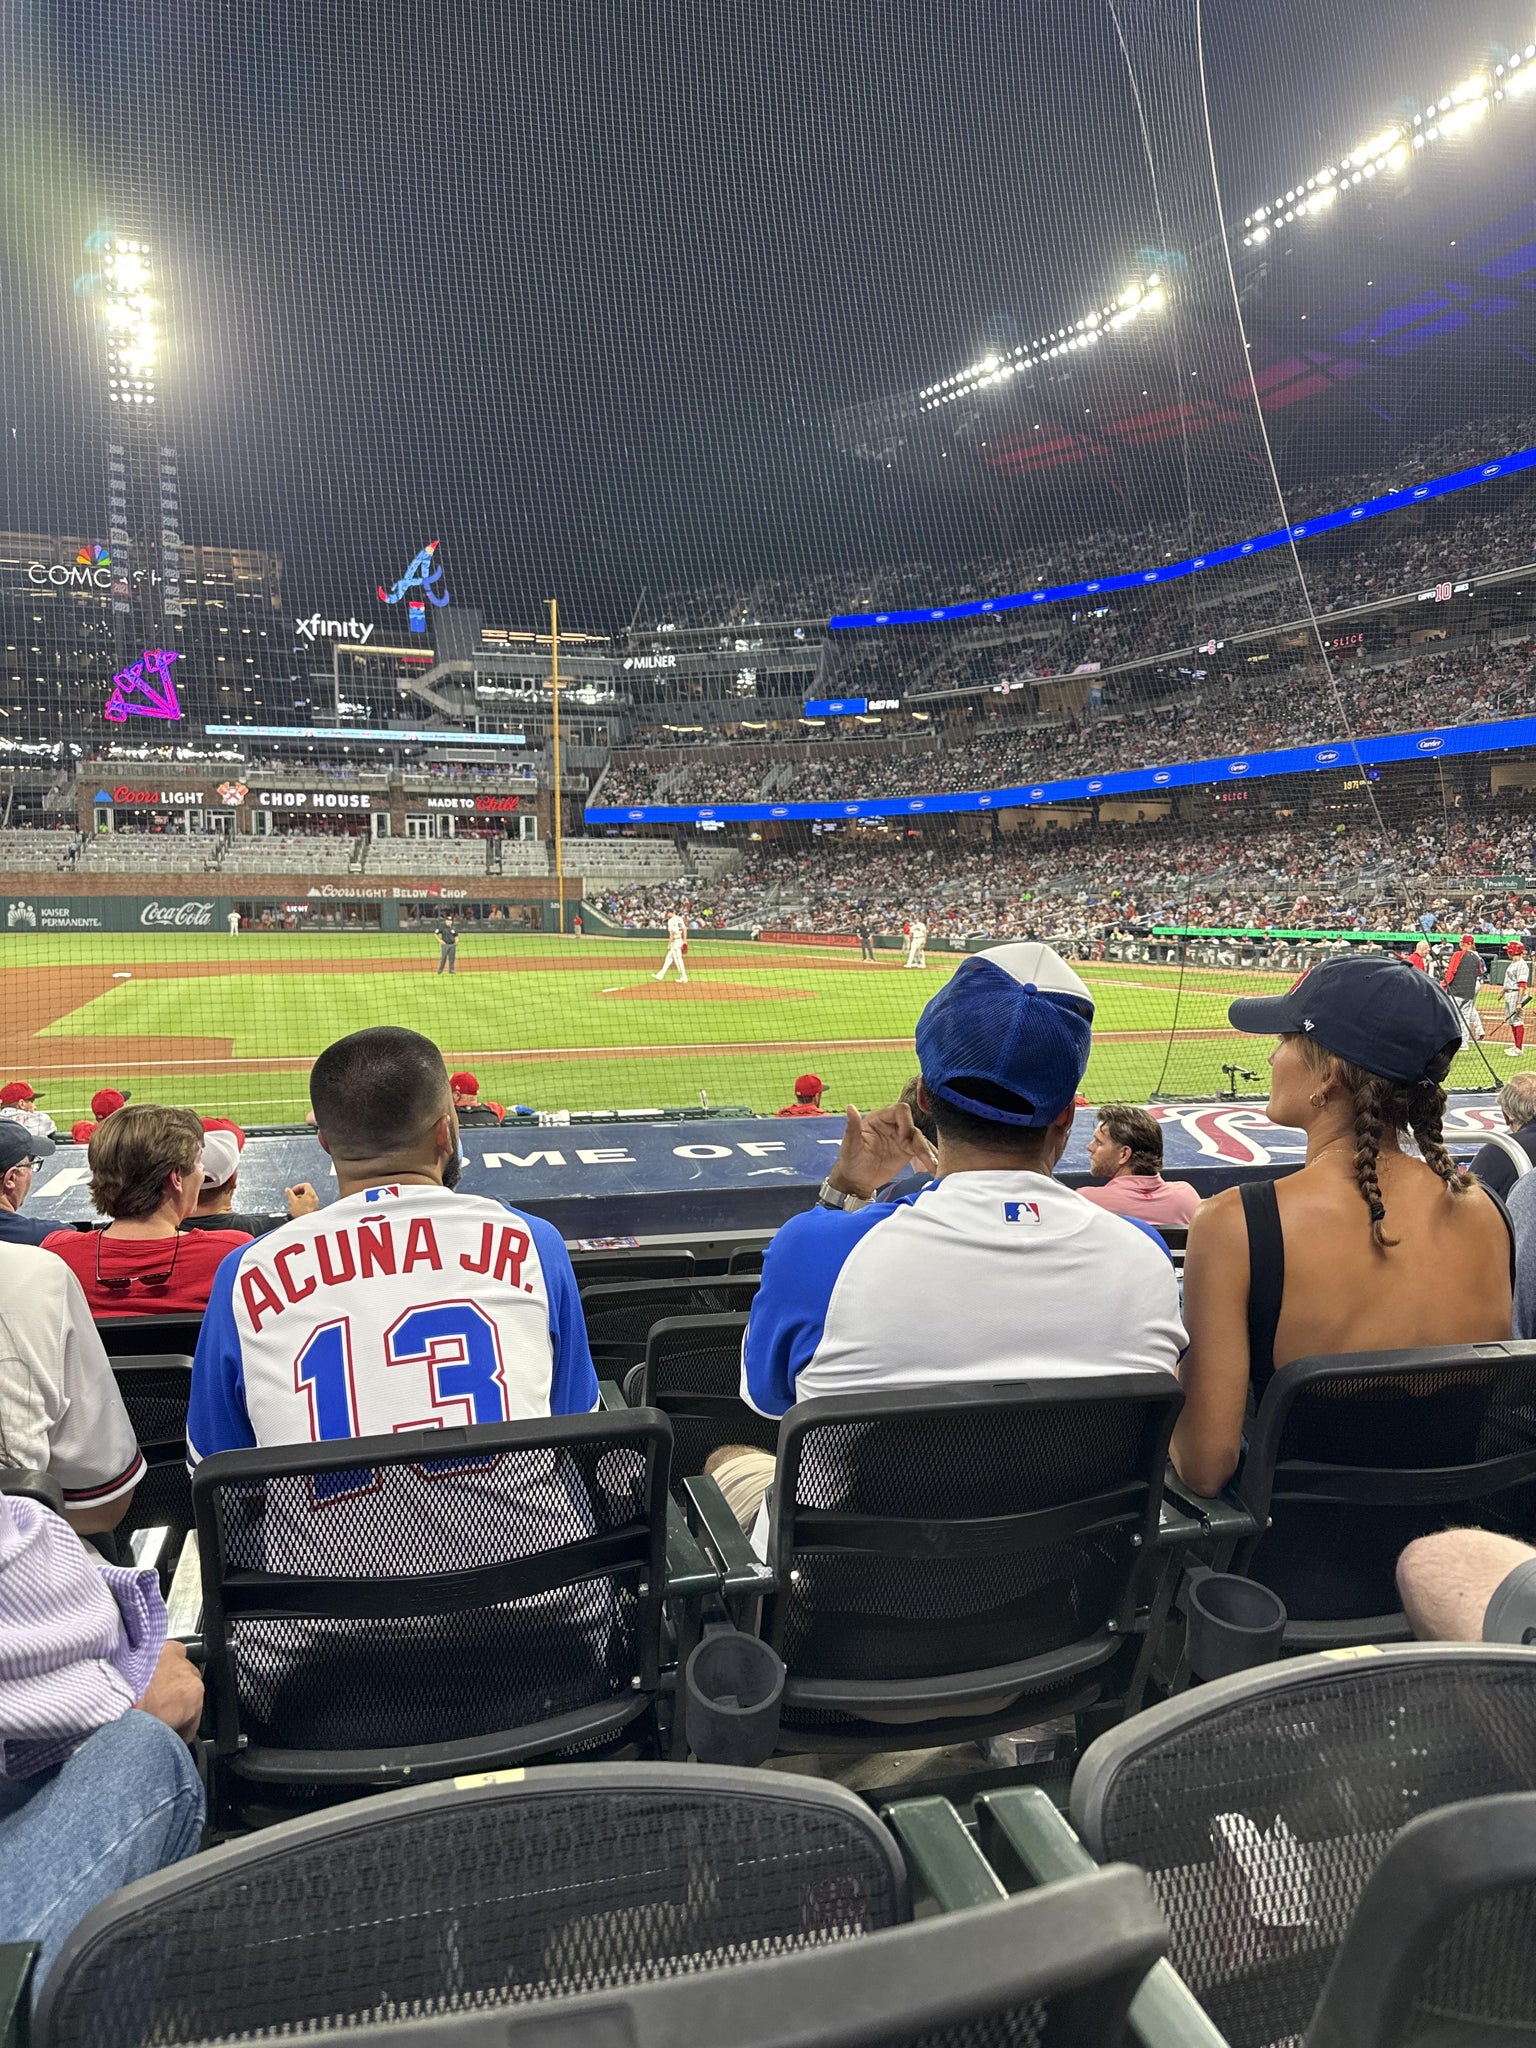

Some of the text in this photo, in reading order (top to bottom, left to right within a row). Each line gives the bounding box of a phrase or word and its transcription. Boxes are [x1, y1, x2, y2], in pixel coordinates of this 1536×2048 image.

[1435, 582, 1452, 602] 10
[295, 613, 374, 644] xfinity
[1333, 633, 1364, 648] SLICE
[633, 655, 677, 669] MILNER
[113, 786, 204, 804] Coors LIGHT
[259, 792, 371, 808] CHOP HOUSE
[427, 795, 520, 811] MADE TO Chill
[1222, 792, 1248, 801] SLICE
[355, 889, 387, 898] LIGHT
[41, 908, 69, 917] KAISER
[41, 917, 99, 927] PERMANENTE
[672, 1140, 787, 1160] OF
[240, 1215, 534, 1333] ACUÑA JR.
[294, 1298, 510, 1508] 13
